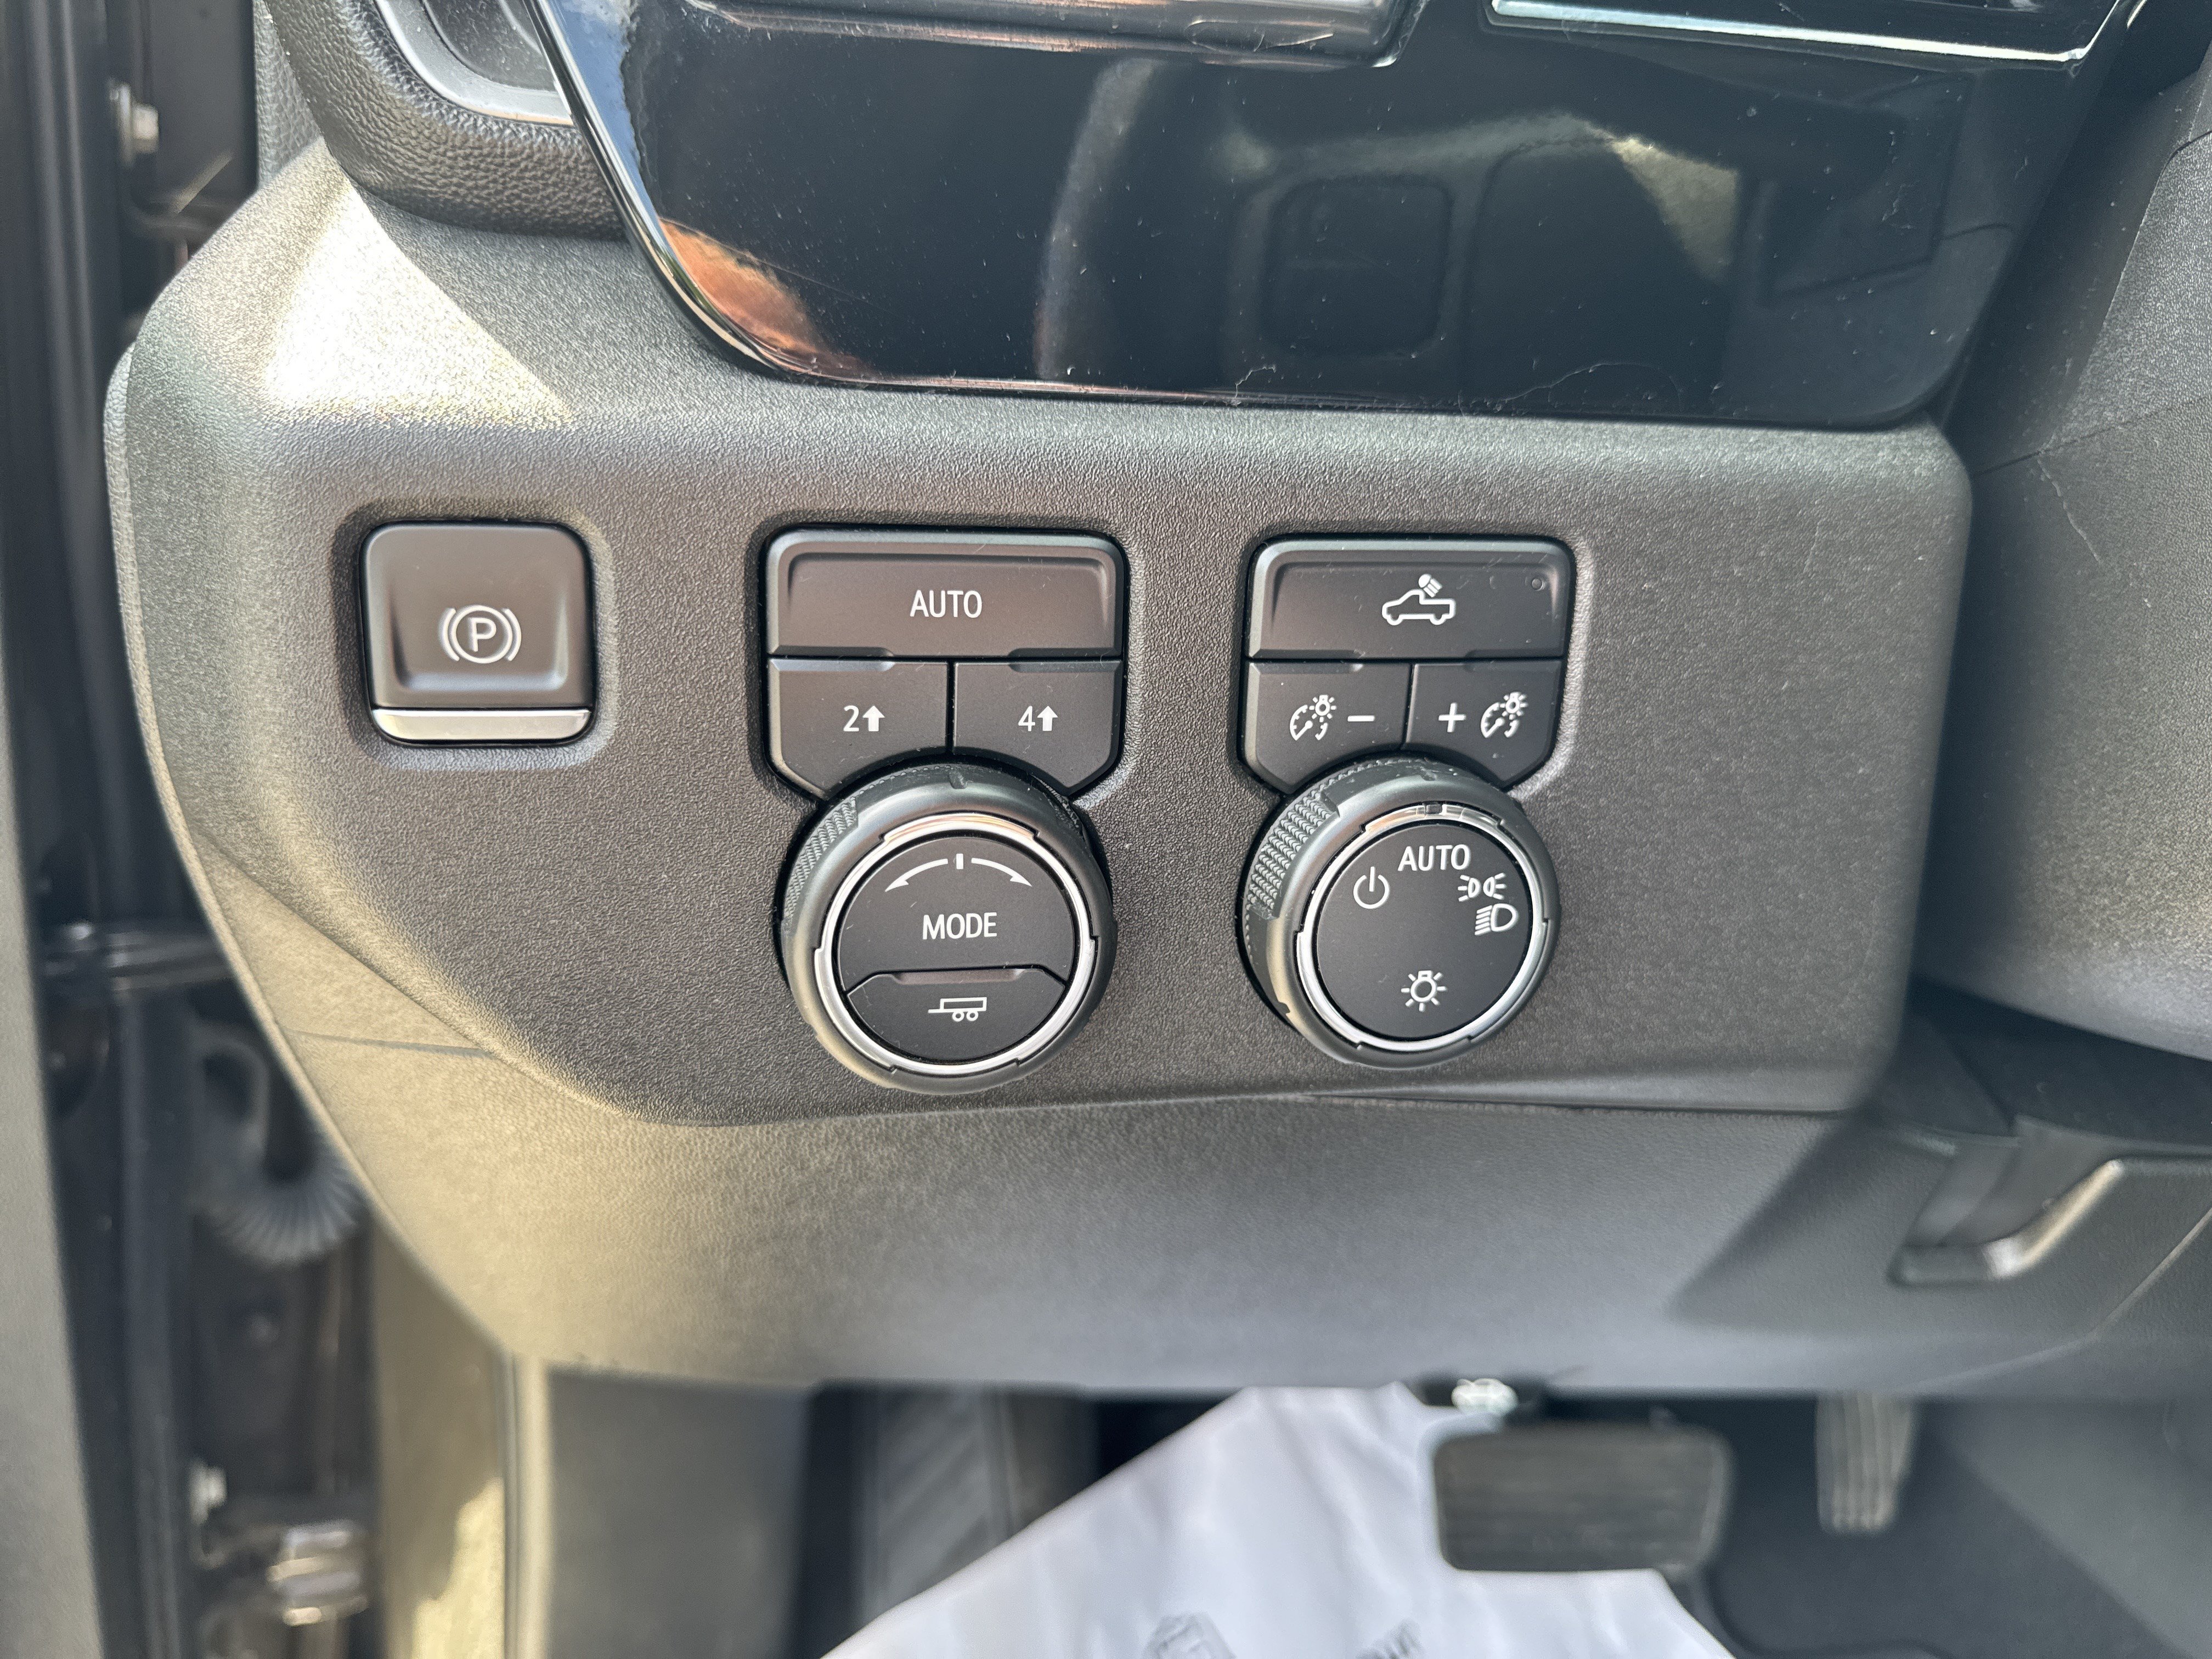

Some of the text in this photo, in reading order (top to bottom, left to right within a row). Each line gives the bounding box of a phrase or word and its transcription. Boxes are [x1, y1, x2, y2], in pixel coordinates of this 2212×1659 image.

[909, 589, 984, 619] AUTO
[843, 704, 861, 732] 2
[1017, 704, 1036, 732] 4
[1397, 843, 1471, 872] AUTO
[921, 911, 998, 940] MODE
